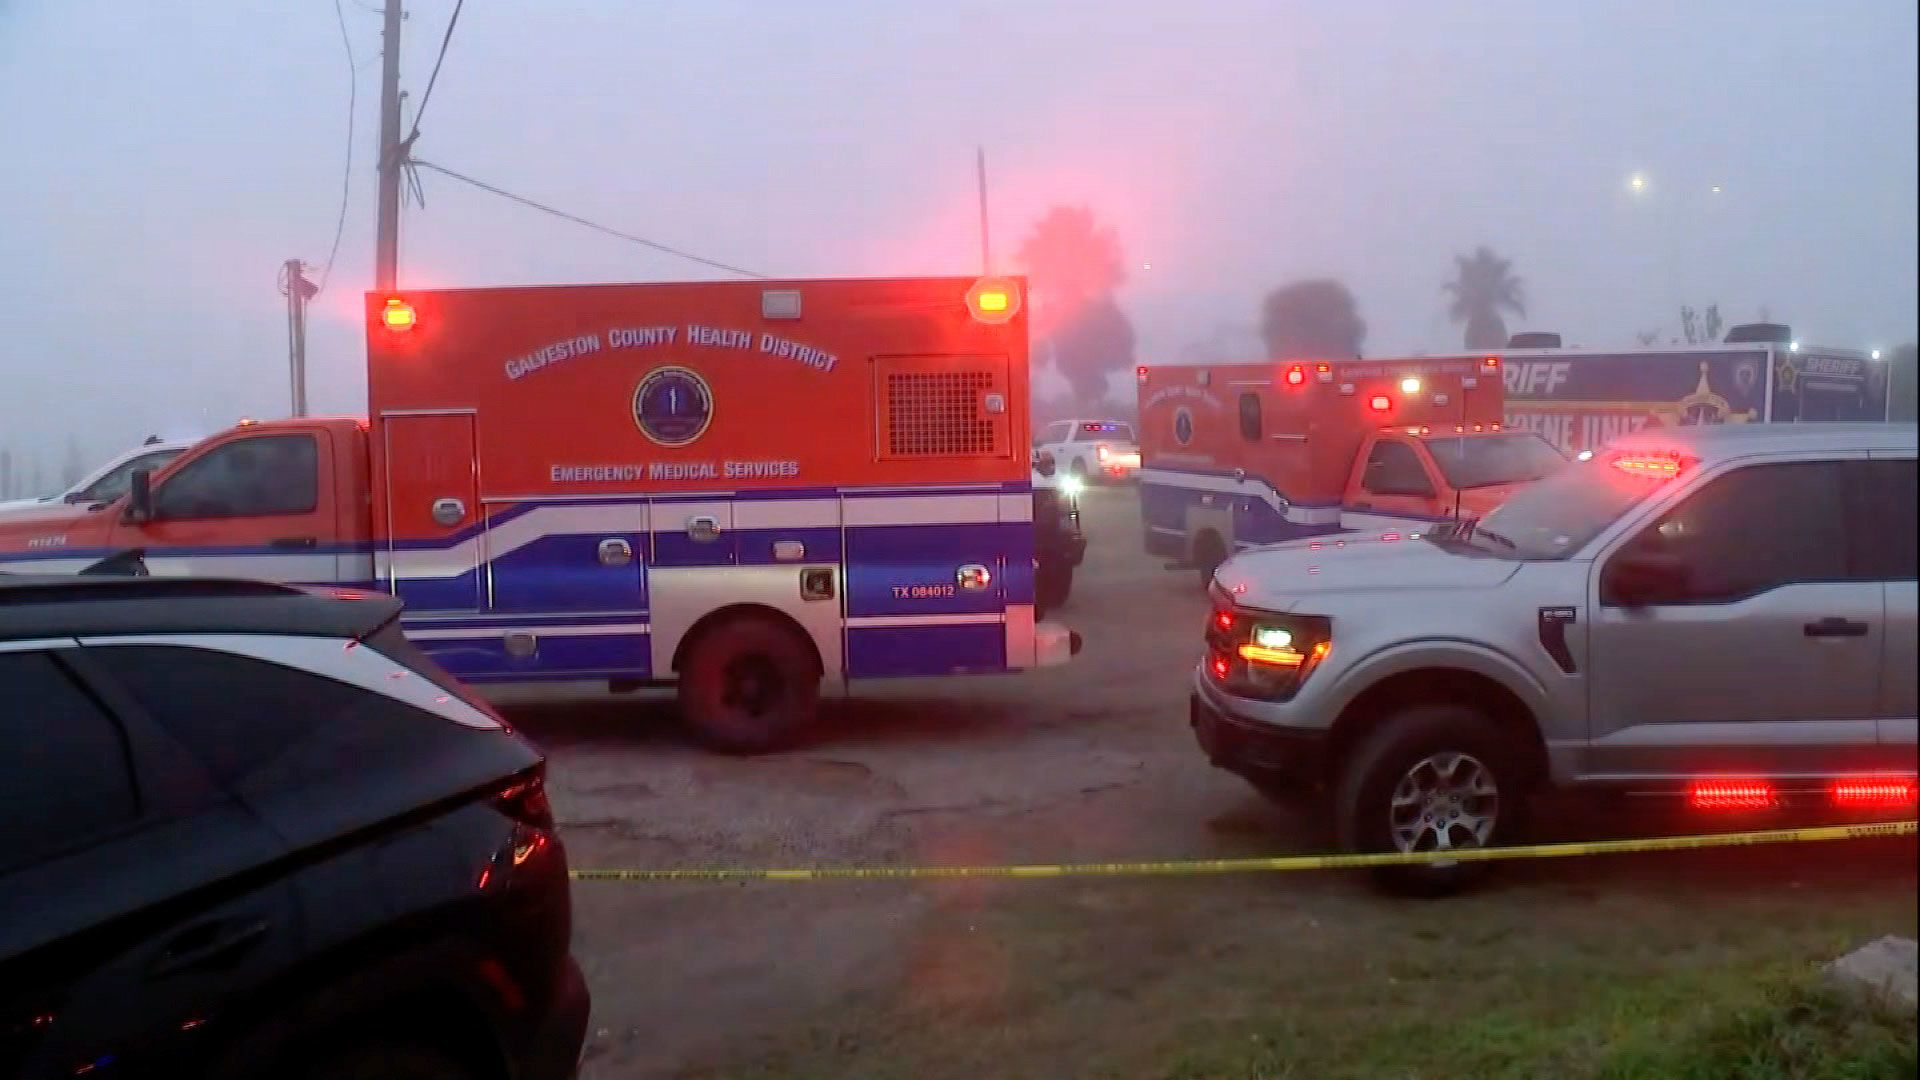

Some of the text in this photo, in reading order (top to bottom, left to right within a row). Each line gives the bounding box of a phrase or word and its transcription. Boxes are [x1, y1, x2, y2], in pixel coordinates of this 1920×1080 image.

[506, 325, 839, 379] GALVESTON COUNTY HEALTH DISTRICT
[1502, 363, 1571, 393] RIFF
[551, 461, 799, 482] EMERGENCY MEDICAL SERVICES
[892, 585, 955, 599] TX 084012
